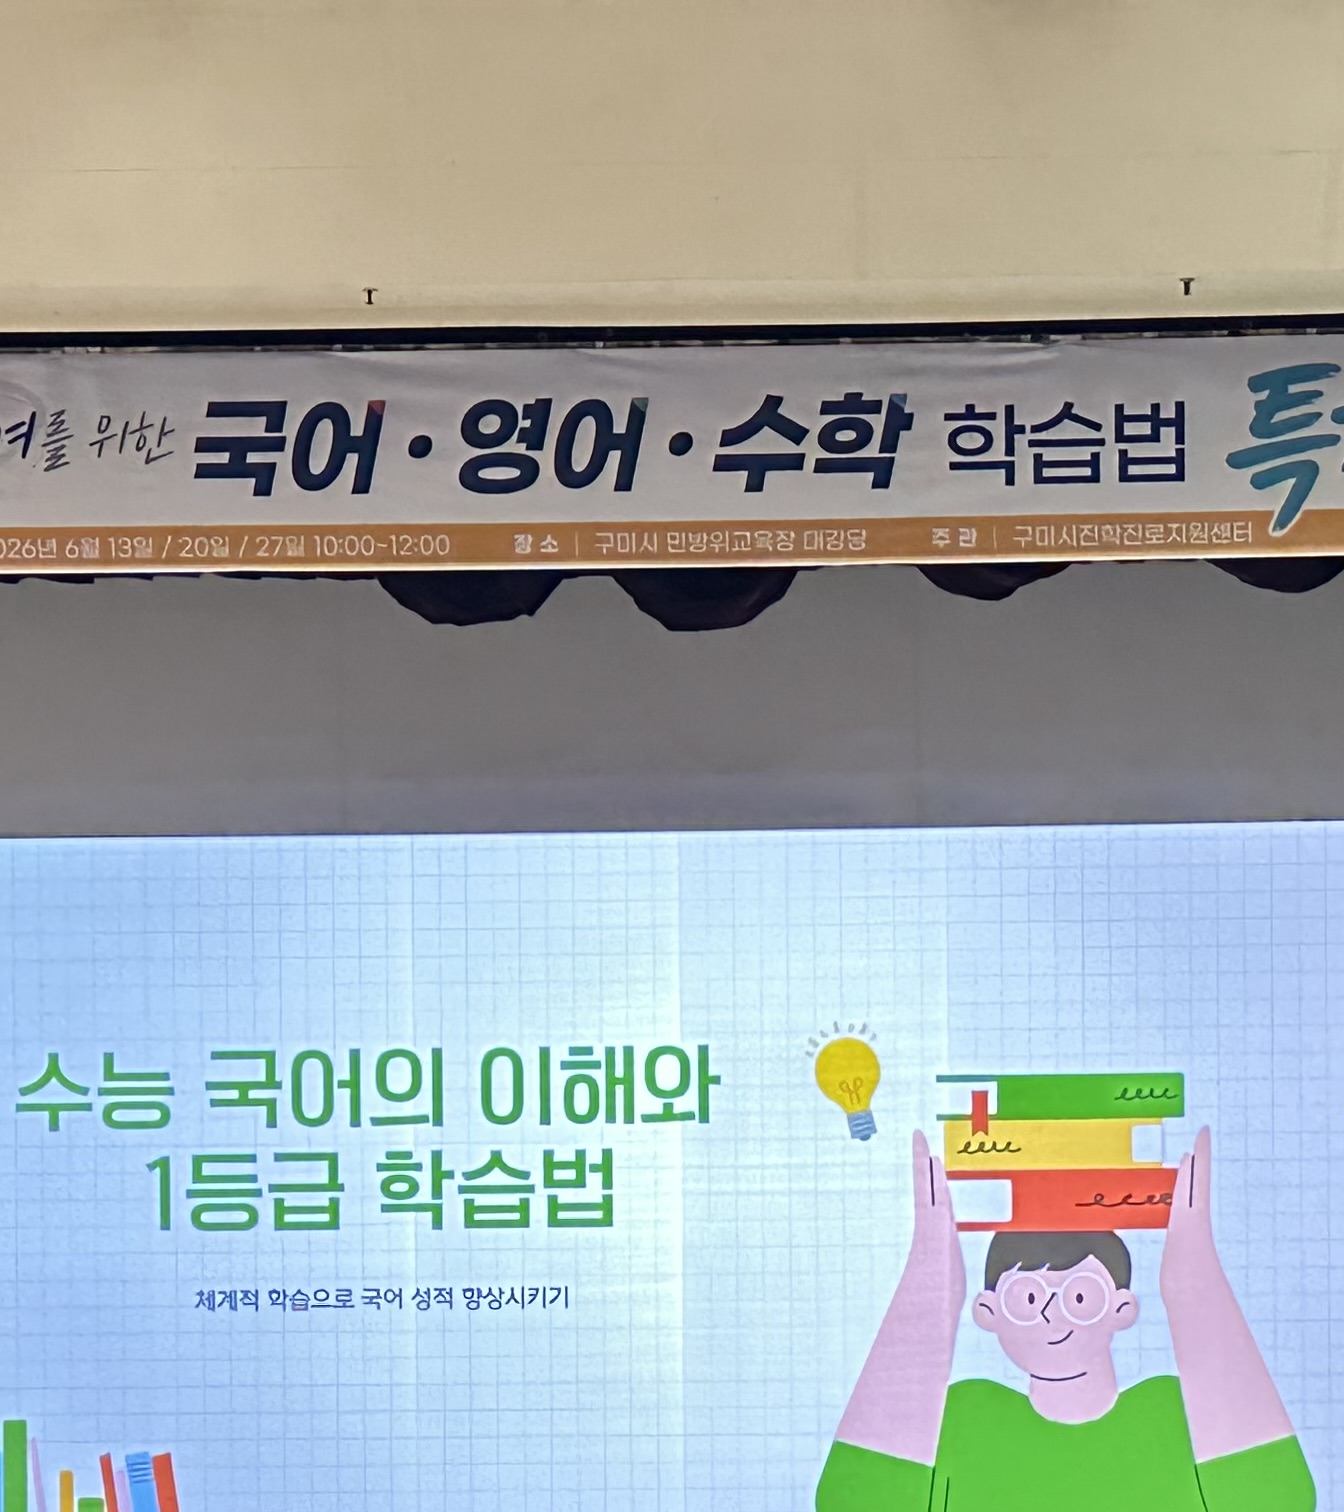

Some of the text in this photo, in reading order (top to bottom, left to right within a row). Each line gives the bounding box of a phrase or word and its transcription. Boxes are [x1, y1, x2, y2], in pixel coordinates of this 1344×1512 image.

[88, 410, 176, 466] 위한
[944, 401, 1186, 487] 학습법
[594, 532, 658, 555] 구미시
[667, 530, 796, 553] 민방위교육장
[1012, 521, 1254, 549] 구미시진학진로지원센터
[15, 1044, 722, 1133] 수능 국어의 이해와
[144, 1149, 614, 1232] 1등급 학습법
[194, 1284, 570, 1314] 체계적 학습으로 국어 성적 향상시키기
